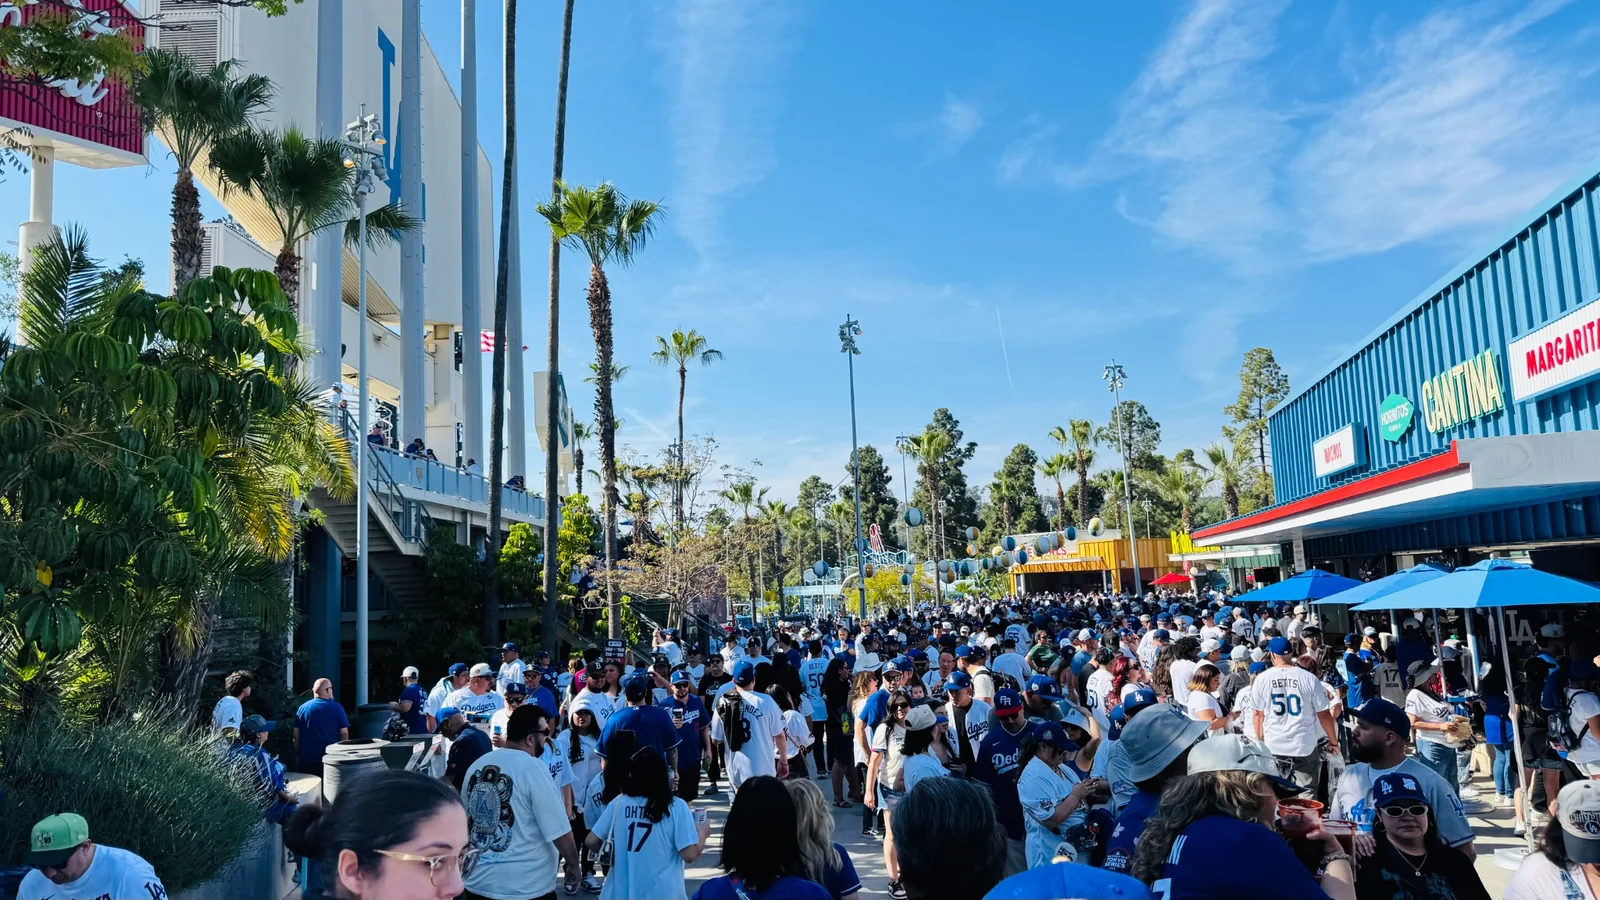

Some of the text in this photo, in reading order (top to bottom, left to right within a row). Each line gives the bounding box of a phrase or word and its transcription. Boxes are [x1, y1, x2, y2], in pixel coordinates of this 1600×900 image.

[1422, 349, 1503, 434] CANTINA
[1381, 402, 1409, 425] HORNITOS
[1506, 609, 1537, 646] LA
[1272, 679, 1298, 688] BETTS
[1383, 669, 1399, 682] 17
[1135, 691, 1144, 702] LA
[1271, 694, 1302, 716] 50
[460, 701, 496, 716] Dodgers
[1380, 780, 1393, 795] LA
[1447, 794, 1464, 818] LA
[627, 821, 653, 852] 17
[1106, 857, 1126, 865] TOKYO
